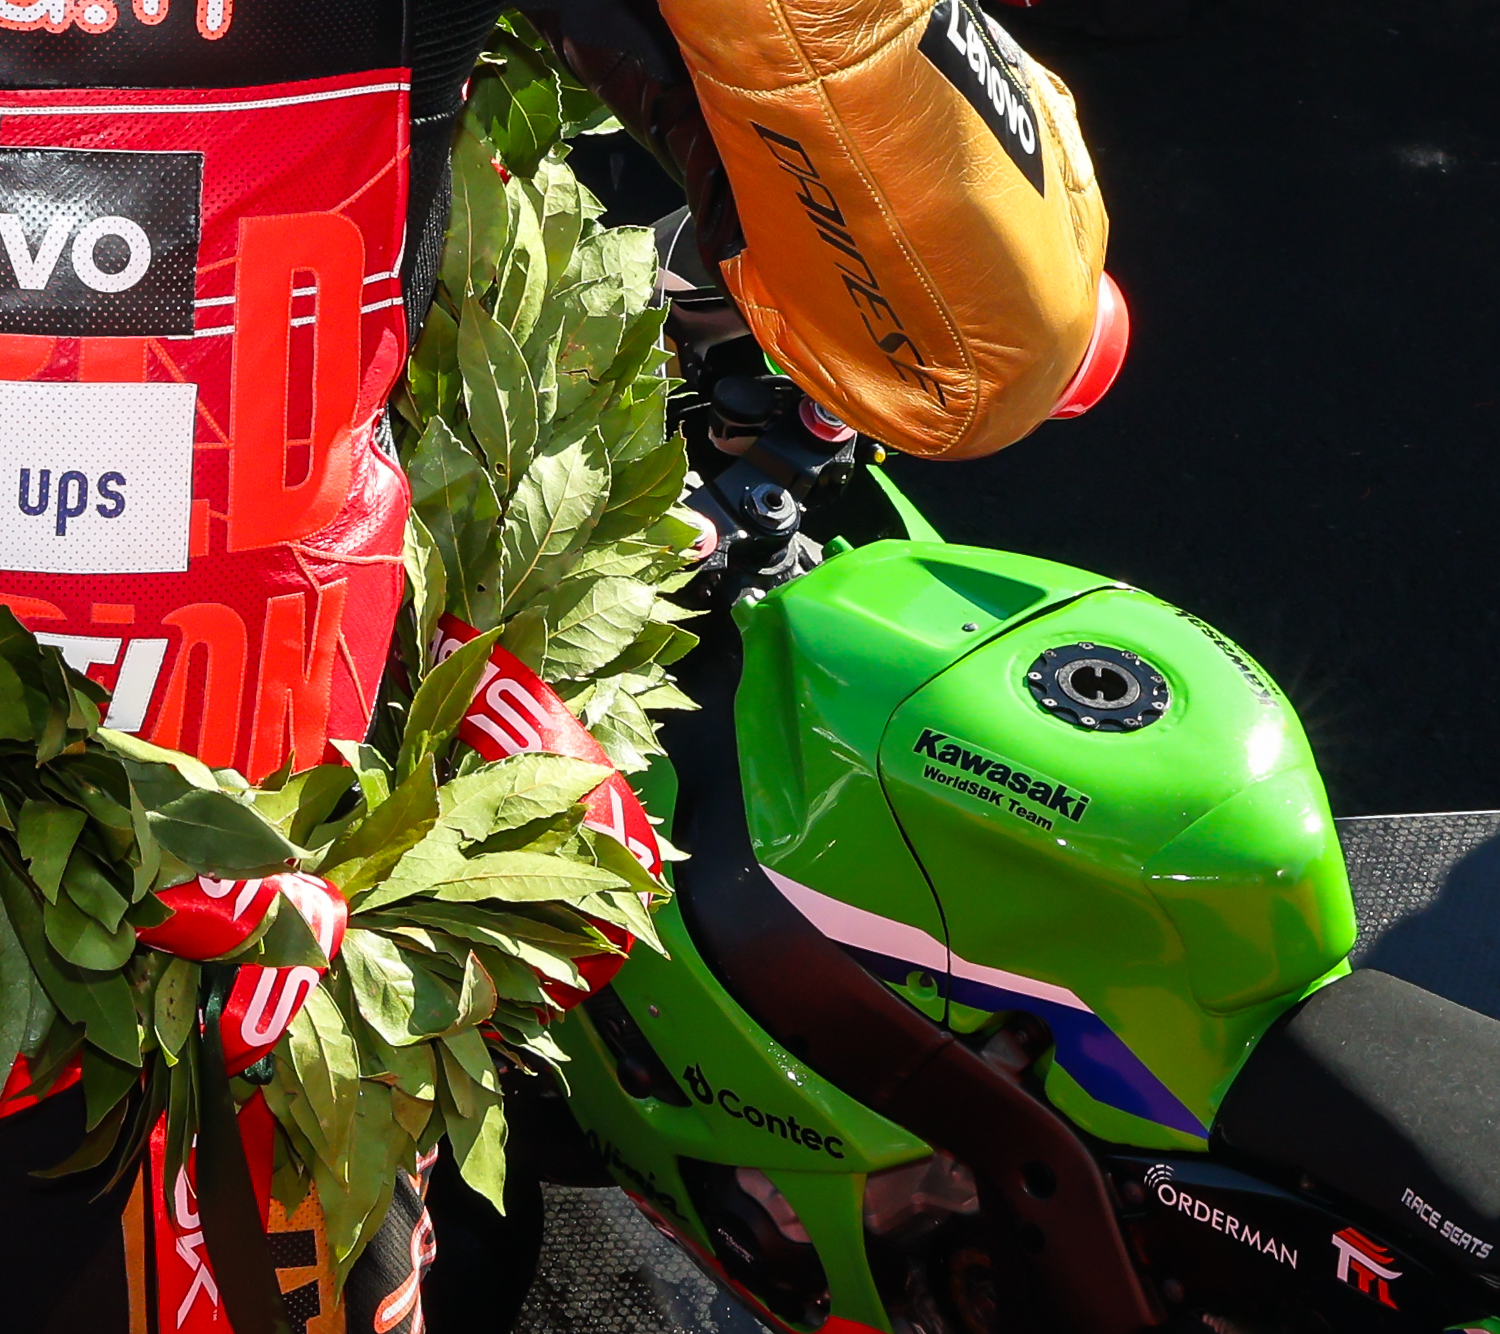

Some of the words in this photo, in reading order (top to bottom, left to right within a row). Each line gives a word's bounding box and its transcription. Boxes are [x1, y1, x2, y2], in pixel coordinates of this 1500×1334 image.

[17, 466, 128, 537] ups
[912, 727, 1092, 825] Kawasaki
[922, 764, 1005, 808] WorldSBK
[1006, 796, 1055, 833] Team
[718, 1089, 846, 1163] Contec
[1155, 1181, 1300, 1272] ORDERMAN
[1400, 1186, 1449, 1236] RACE
[1439, 1215, 1496, 1261] SEATS
